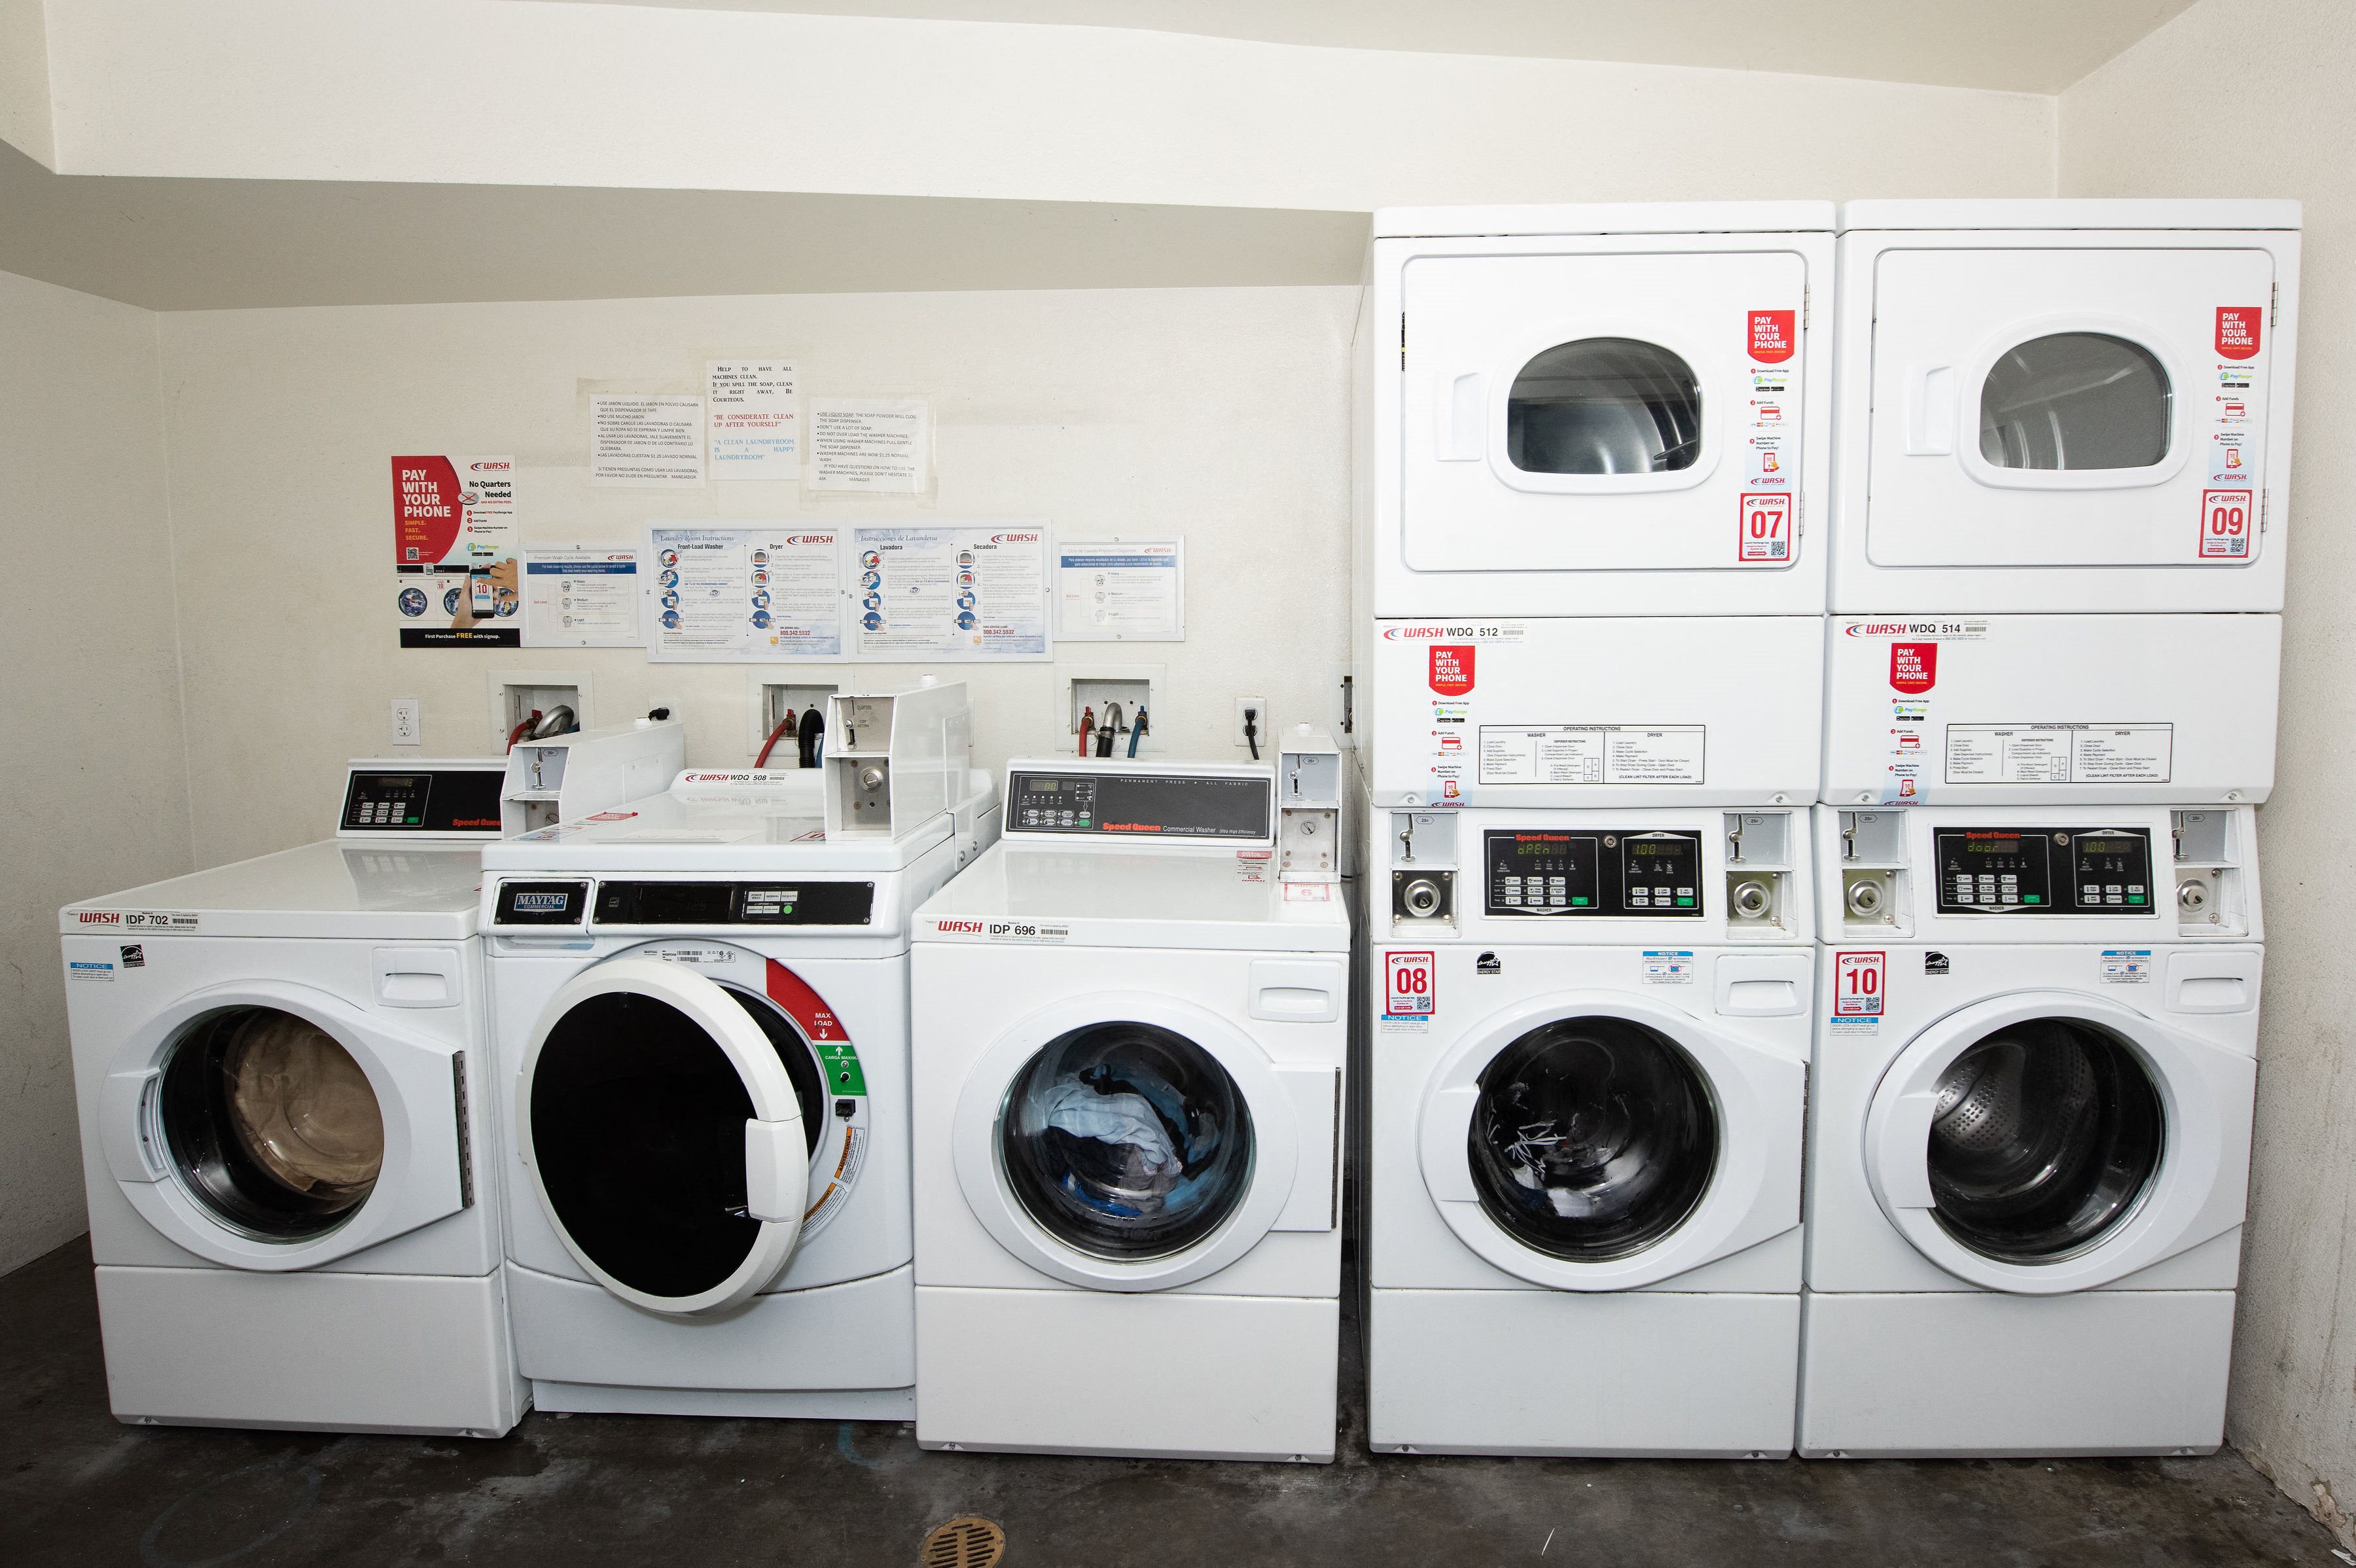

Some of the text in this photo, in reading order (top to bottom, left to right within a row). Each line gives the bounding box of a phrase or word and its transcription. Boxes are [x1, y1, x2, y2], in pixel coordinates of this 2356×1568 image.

[402, 470, 427, 480] PAY
[402, 482, 437, 492] WITH
[403, 494, 440, 505] YOUR
[404, 507, 451, 517] PHONE
[1751, 510, 1783, 538] 07
[2212, 507, 2243, 535] 09
[476, 584, 487, 593] 10
[1404, 628, 1444, 637] WASH
[1866, 624, 1906, 633] WASH
[1909, 624, 1960, 633] WDQ 514
[1103, 823, 1131, 831] Speed
[518, 896, 563, 904] MAYTAG
[80, 913, 120, 923] WASH
[126, 915, 168, 925] IDP 702
[938, 921, 983, 933] WASH
[990, 925, 1035, 935] IDP 696
[1397, 968, 1427, 994] 08
[1847, 969, 1877, 995] 10
